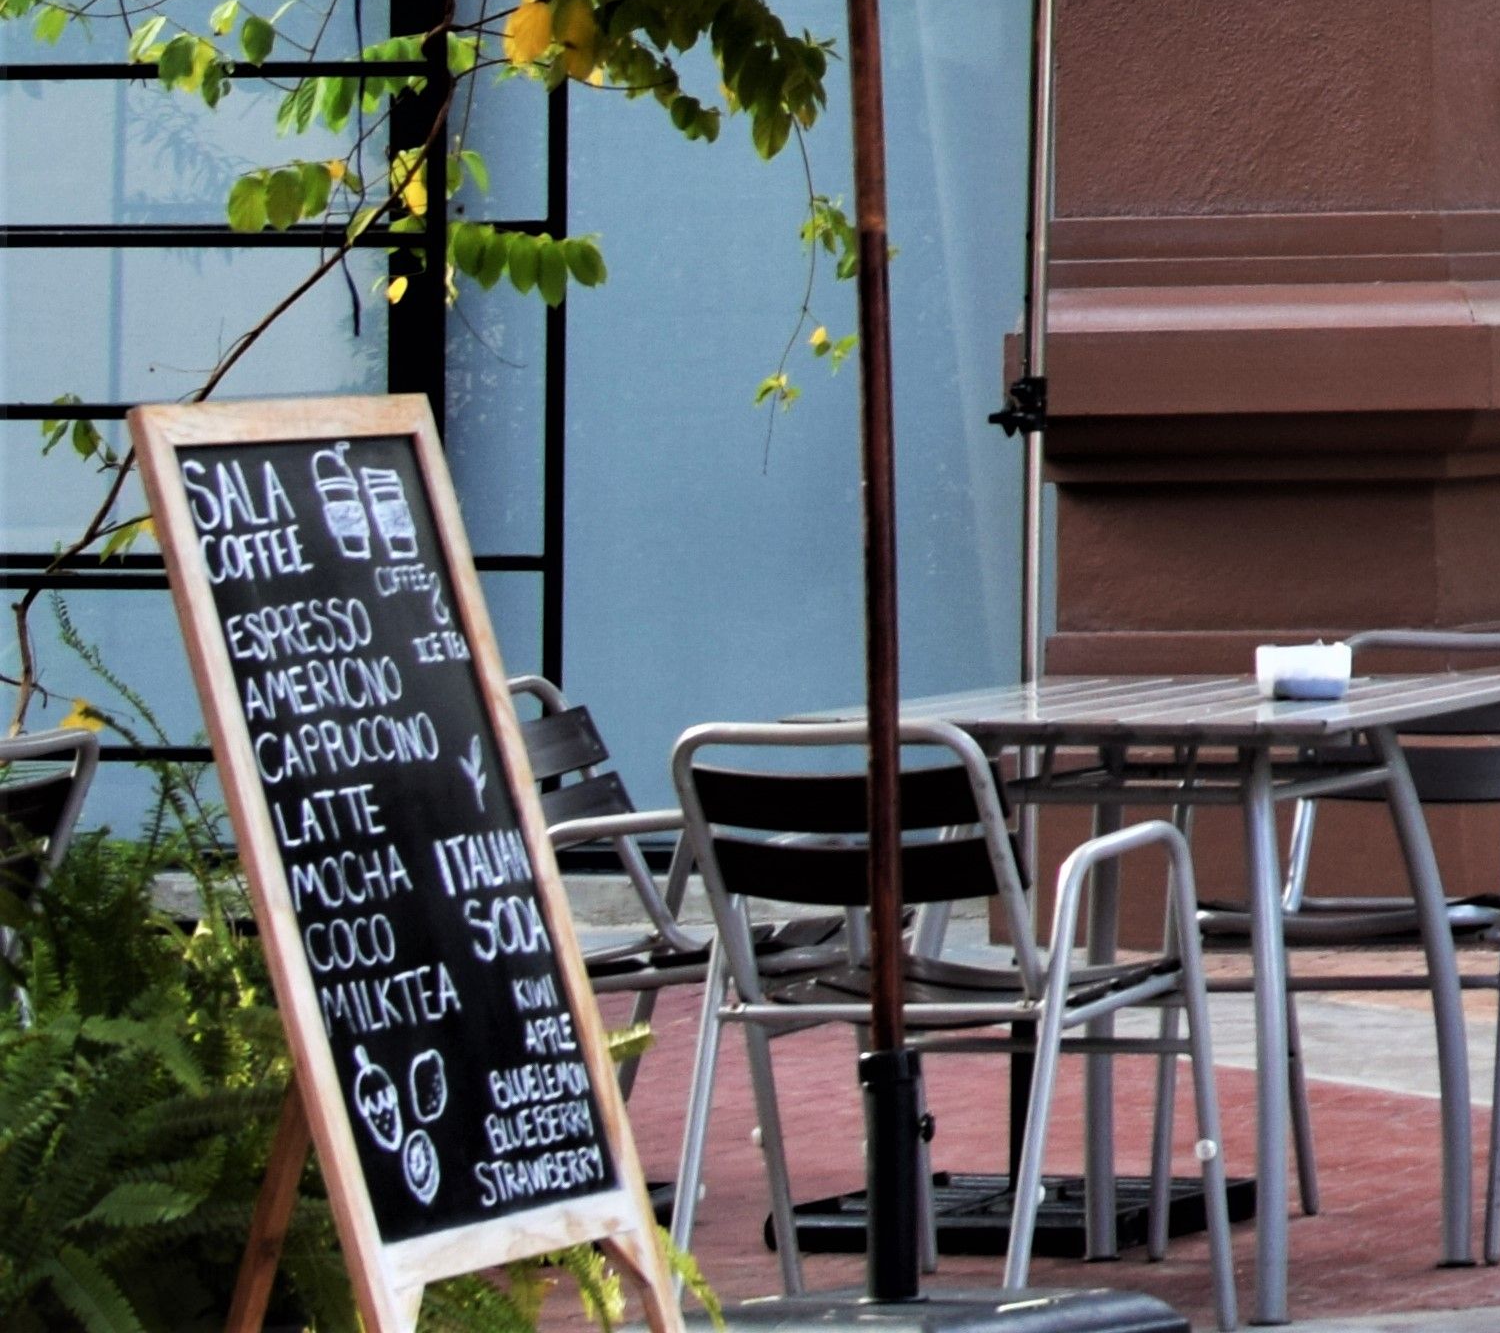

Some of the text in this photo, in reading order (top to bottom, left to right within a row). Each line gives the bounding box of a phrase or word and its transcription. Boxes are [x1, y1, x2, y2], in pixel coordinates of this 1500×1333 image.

[181, 459, 296, 531] SALA
[199, 524, 314, 586] COFFEE
[226, 598, 373, 663] ESPRESSO
[245, 656, 403, 722] AMERICNO
[253, 712, 440, 785] CAPPUCCINO
[274, 783, 387, 848] LATTE
[290, 829, 533, 912] MOCHA ITALIAN
[304, 894, 552, 974] COCO SODA
[511, 973, 557, 1013] KIWI
[524, 1012, 578, 1056] APPLE
[485, 1099, 596, 1156] BLUEBERRY
[474, 1144, 606, 1208] STRAWBERRY
